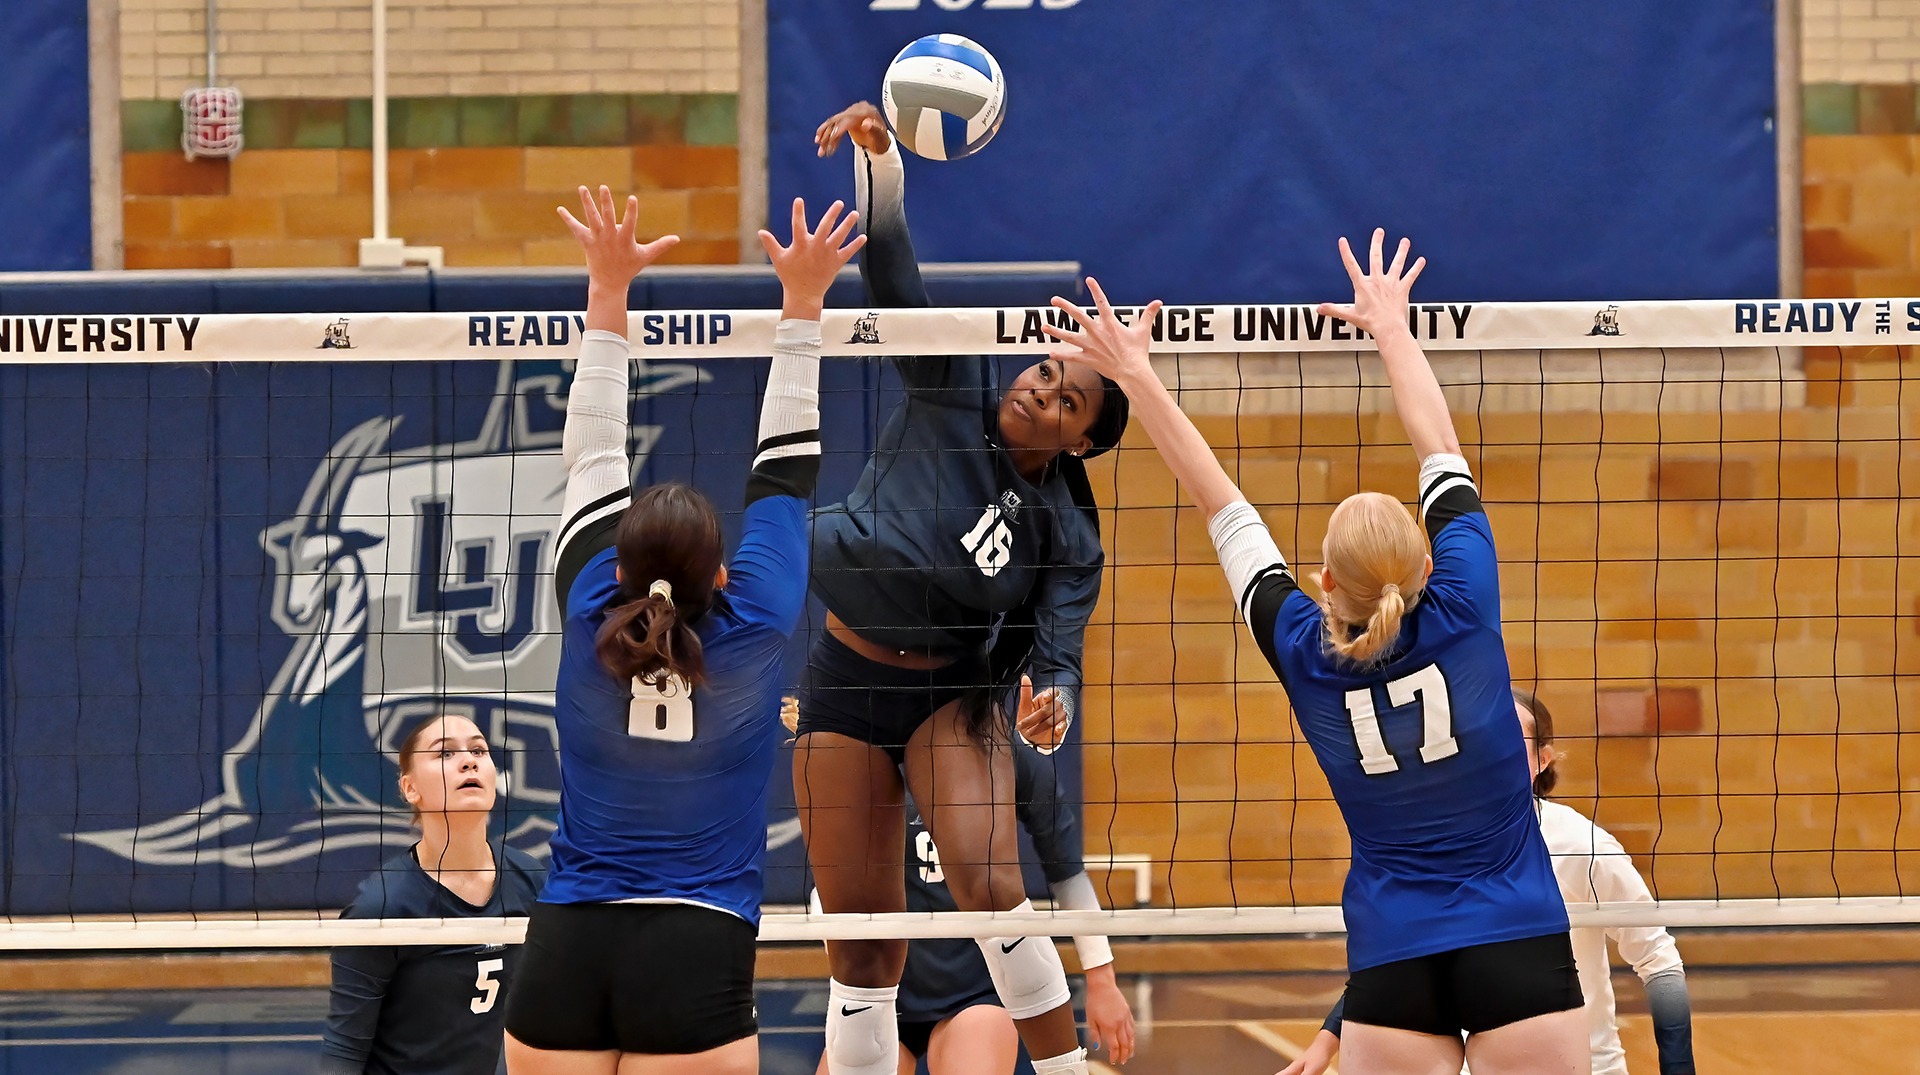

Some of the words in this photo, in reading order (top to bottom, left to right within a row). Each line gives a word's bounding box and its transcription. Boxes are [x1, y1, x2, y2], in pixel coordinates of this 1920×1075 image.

[644, 314, 731, 345] SHIP
[996, 308, 1214, 343] LAWNCE
[1233, 305, 1472, 341] UNIVEITY
[1735, 302, 1861, 333] READY
[1875, 301, 1890, 334] THE
[960, 504, 1013, 577] 16
[628, 668, 693, 742] 8
[1345, 663, 1459, 775] 17
[915, 831, 945, 883] 9
[470, 958, 503, 1014] 5
